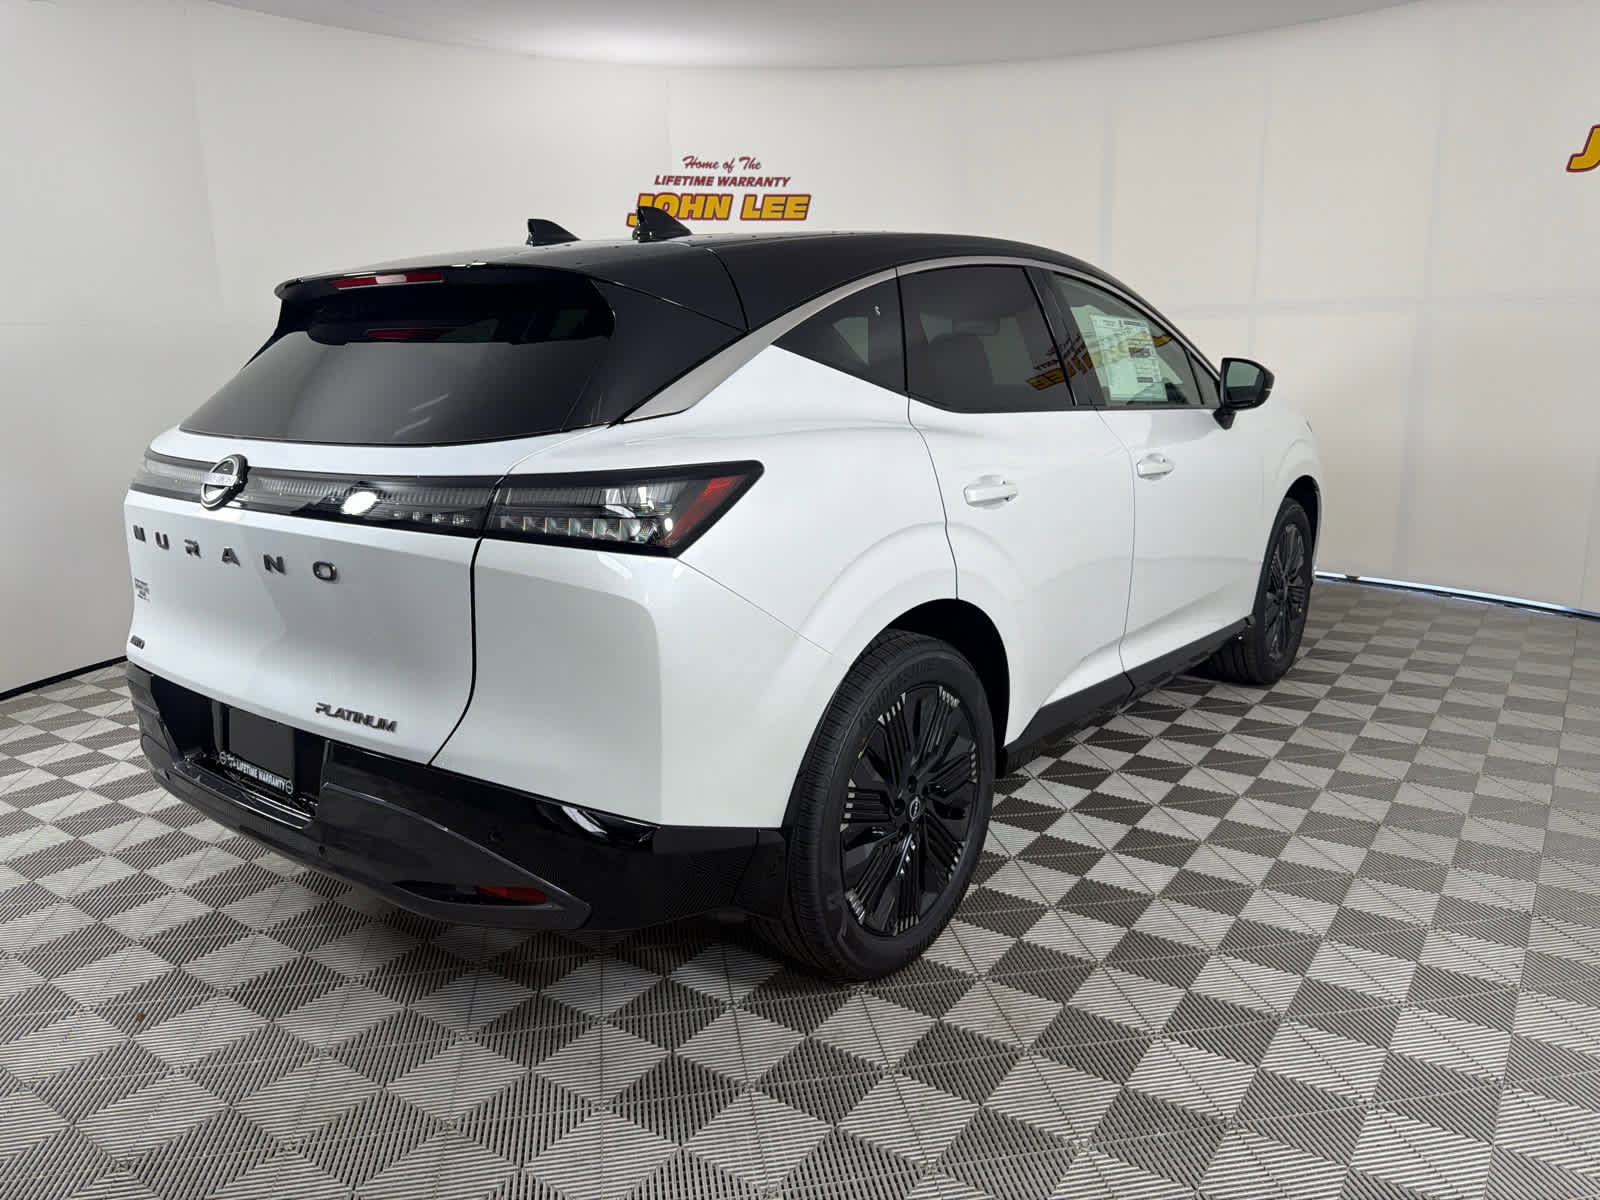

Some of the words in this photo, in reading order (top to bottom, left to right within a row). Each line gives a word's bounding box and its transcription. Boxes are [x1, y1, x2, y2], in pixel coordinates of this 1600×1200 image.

[682, 155, 719, 170] Home
[723, 158, 735, 173] of
[739, 156, 761, 170] The
[654, 175, 714, 187] LIFETIME
[717, 176, 791, 188] WARRANTY
[740, 194, 811, 221] LEE
[133, 524, 338, 582] MURANO
[315, 702, 397, 732] PLATINUM
[236, 759, 258, 779] LIFETIME
[258, 769, 286, 792] WARRANTY
